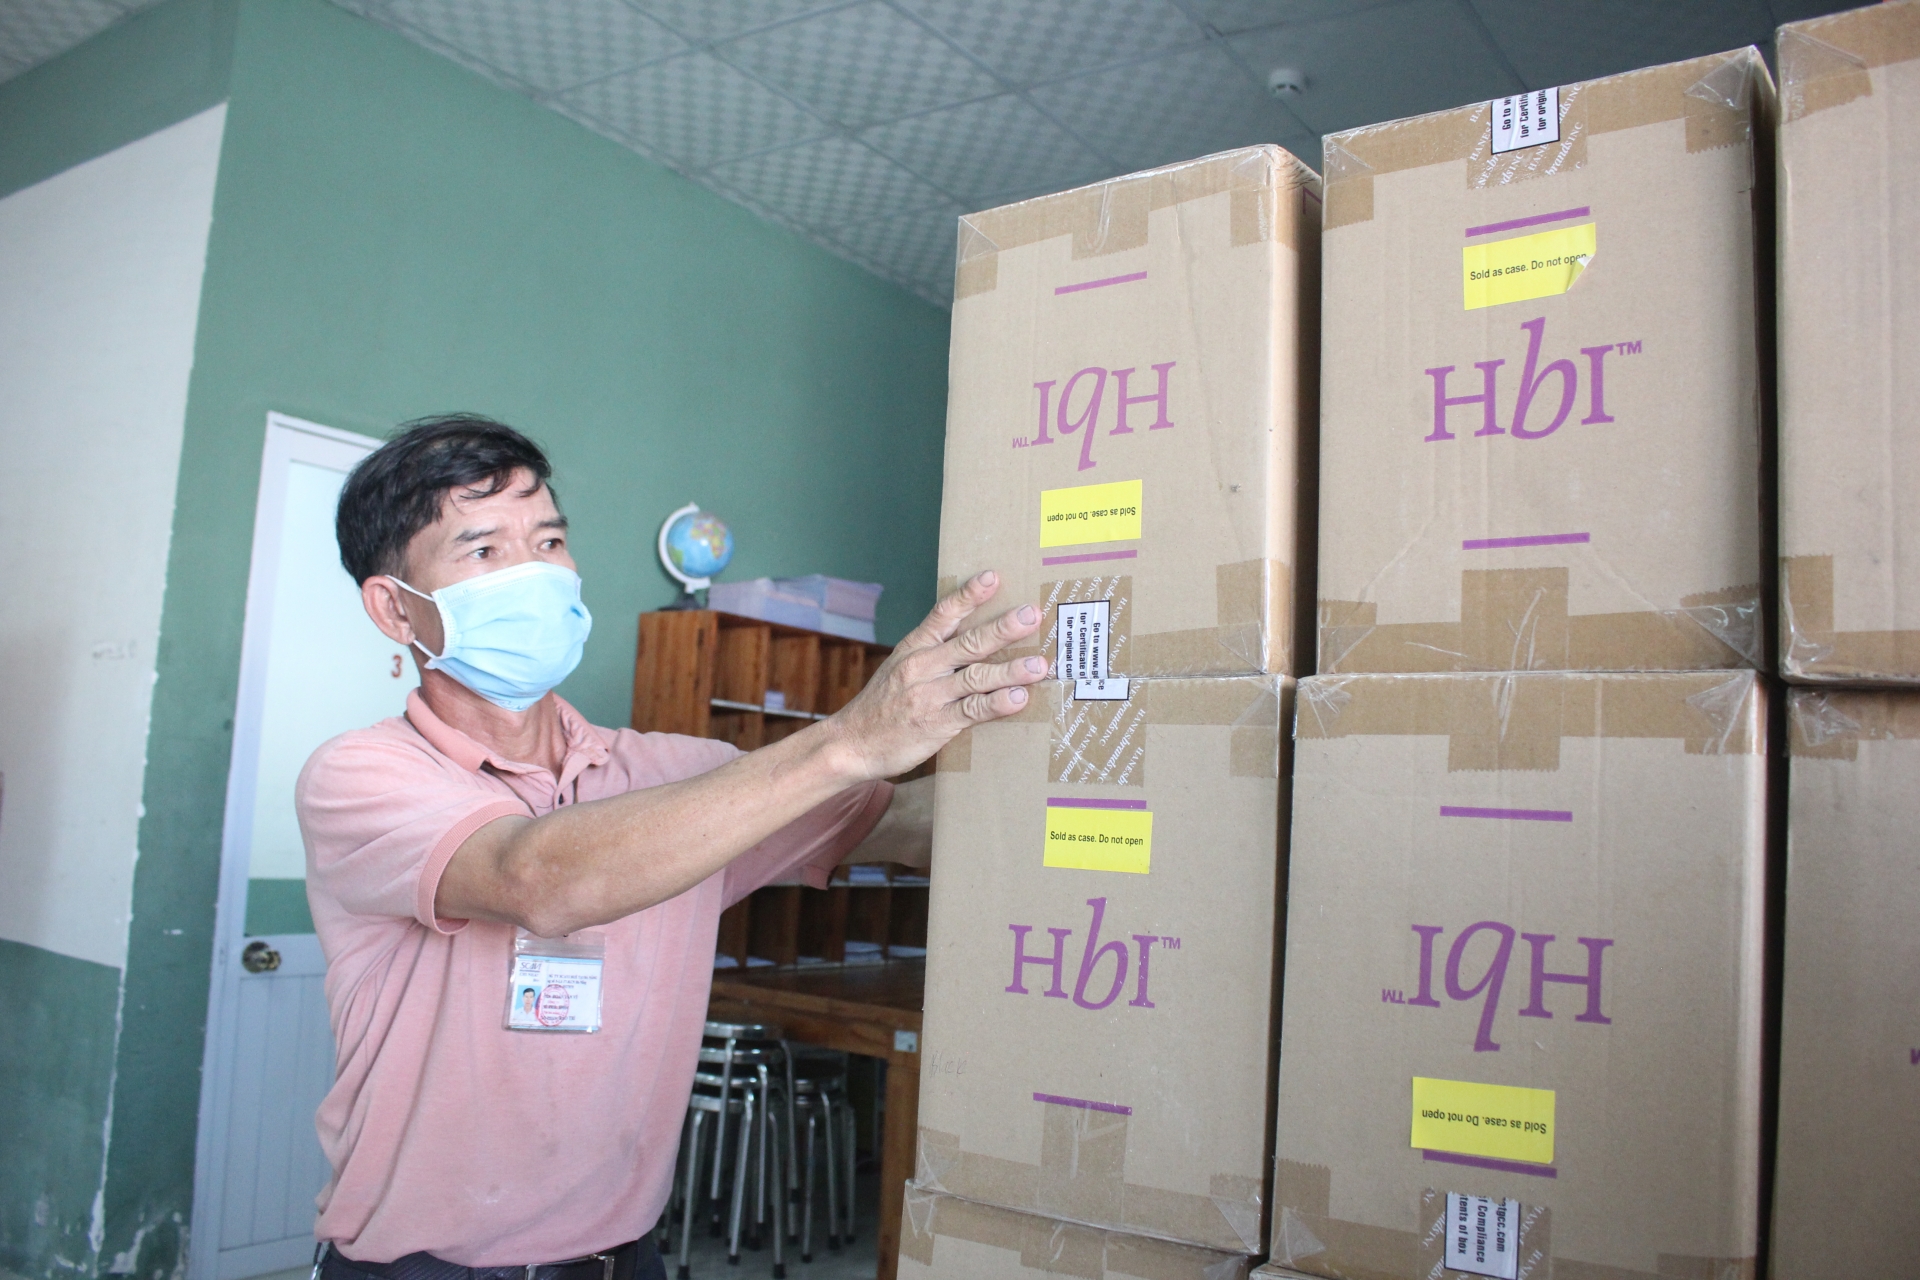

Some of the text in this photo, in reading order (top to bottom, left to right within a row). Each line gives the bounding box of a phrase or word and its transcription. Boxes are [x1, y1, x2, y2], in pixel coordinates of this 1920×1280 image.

[1502, 107, 1511, 118] to
[1502, 119, 1511, 131] Go
[1520, 125, 1529, 138] for
[1537, 118, 1547, 131] for
[1470, 271, 1490, 281] Sold
[1492, 268, 1503, 277] as
[1505, 264, 1529, 275] case.
[1531, 260, 1544, 270] Do
[1546, 256, 1562, 267] not
[1046, 506, 1136, 522] Sold as case. Do not open
[1066, 616, 1074, 629] for
[1079, 611, 1087, 625] for
[1093, 622, 1101, 633] Go
[1065, 631, 1074, 662] original
[1092, 635, 1100, 644] to
[1079, 627, 1087, 670] Certificate
[392, 655, 402, 678] 3
[1050, 831, 1066, 840] Sold
[1099, 834, 1109, 843] Do
[1111, 836, 1123, 844] not
[1125, 838, 1143, 846] open
[1422, 1109, 1546, 1134] Sold as case. Do not open
[1458, 1194, 1469, 1255] tents of box
[1476, 1205, 1488, 1263] Compliance
